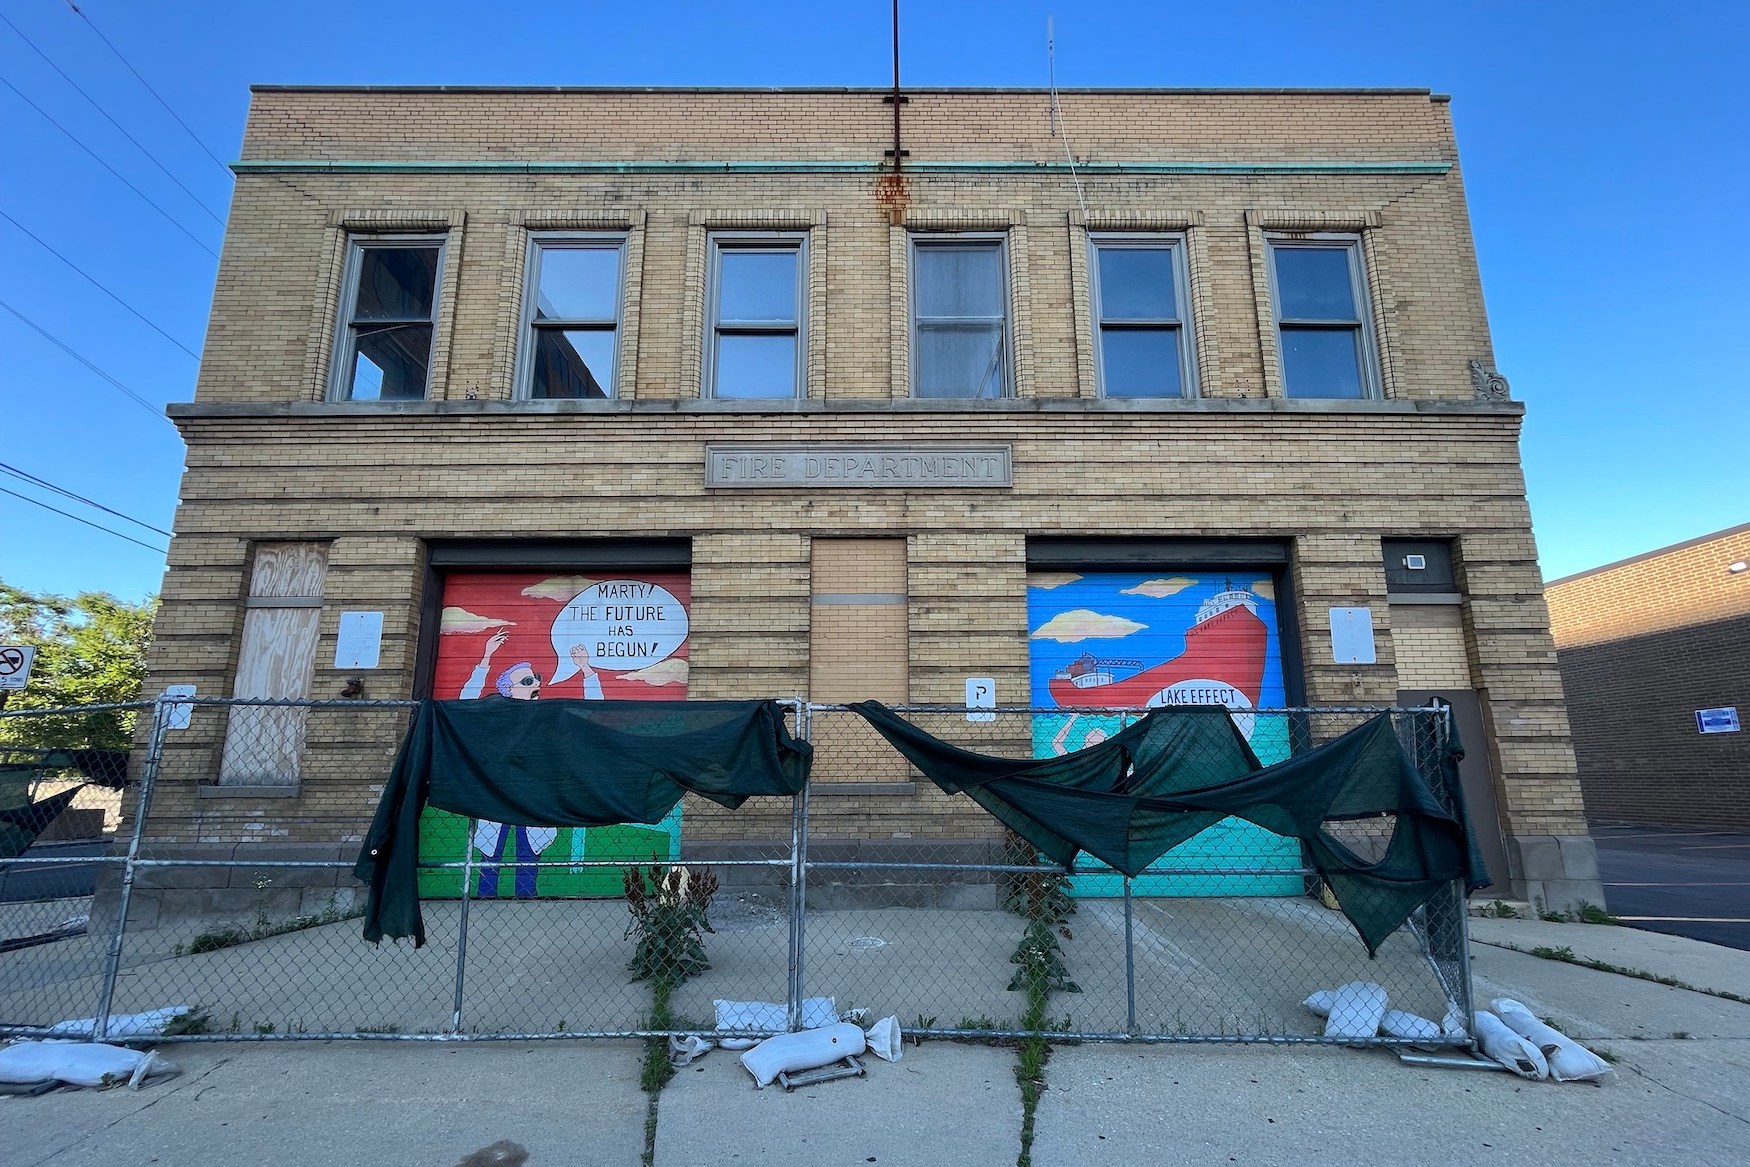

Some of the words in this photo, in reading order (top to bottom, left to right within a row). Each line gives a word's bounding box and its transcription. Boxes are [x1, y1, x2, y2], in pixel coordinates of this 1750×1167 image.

[721, 458, 786, 479] FIRE
[804, 457, 998, 479] DEPARTMENT
[598, 584, 655, 599] MARTY!
[569, 606, 598, 621] THE
[605, 606, 666, 621] FUTURE
[608, 625, 634, 637] HAS
[596, 642, 659, 657] BEGUN!
[1160, 689, 1188, 704] LAKE
[1190, 689, 1235, 704] EFFECT
